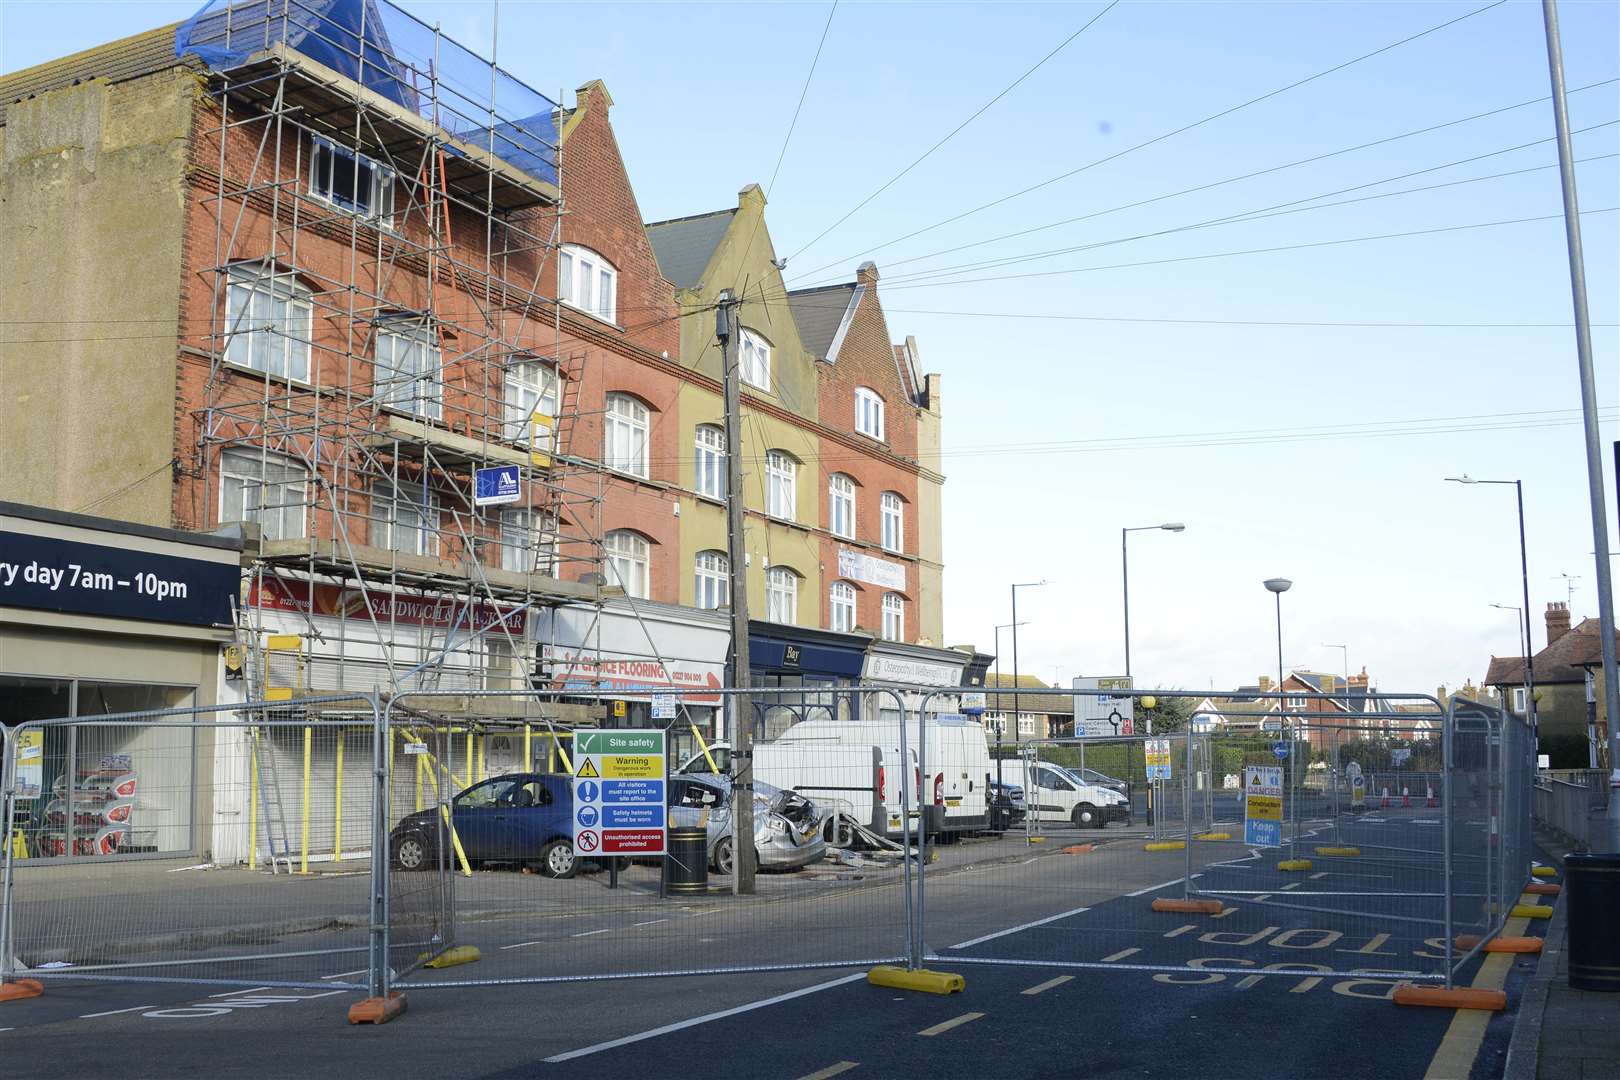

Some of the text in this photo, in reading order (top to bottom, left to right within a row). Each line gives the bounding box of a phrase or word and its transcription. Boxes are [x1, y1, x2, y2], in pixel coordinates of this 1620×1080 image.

[24, 561, 64, 591] day
[69, 564, 113, 591] 7am
[135, 572, 187, 601] 10pm
[618, 660, 664, 679] FLOORING
[609, 738, 655, 748] Site safety
[616, 757, 649, 766] Warning
[623, 789, 640, 797] report
[1247, 786, 1281, 795] DANGER
[1252, 821, 1274, 833] Keep
[1255, 835, 1271, 844] out
